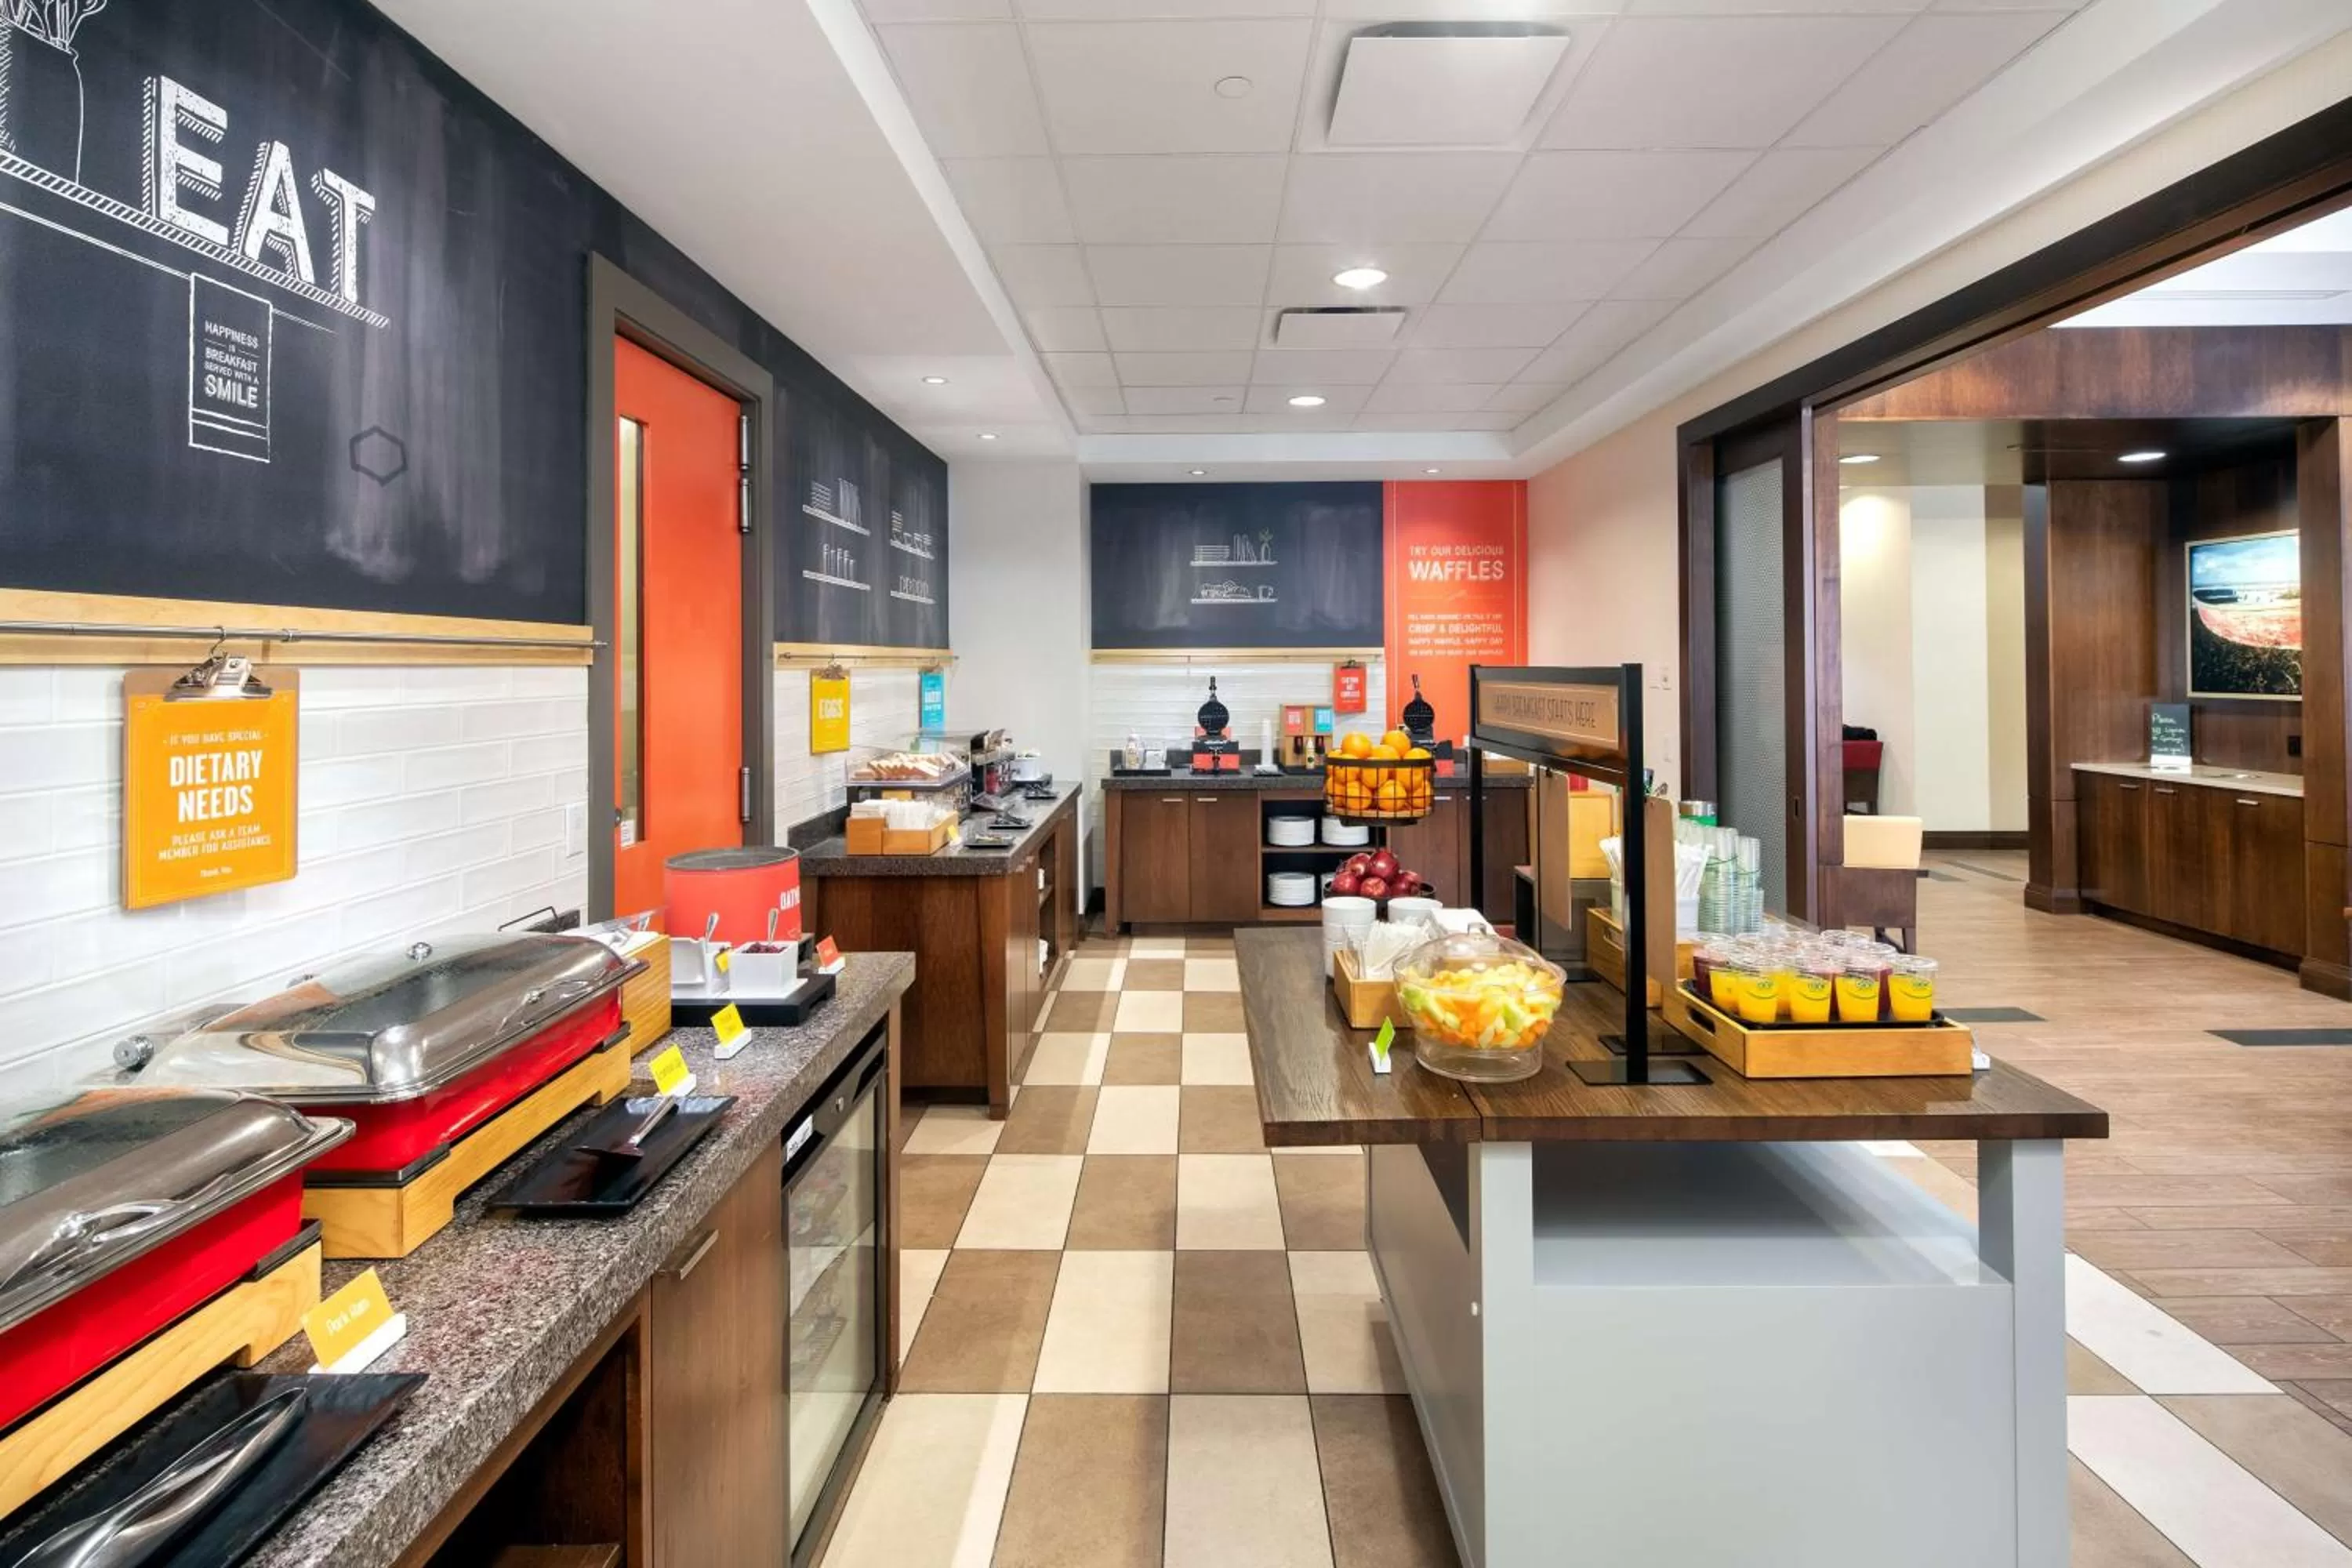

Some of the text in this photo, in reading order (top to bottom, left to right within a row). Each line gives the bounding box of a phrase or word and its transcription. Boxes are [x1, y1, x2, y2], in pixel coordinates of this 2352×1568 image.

[143, 75, 376, 303] EAT
[205, 320, 259, 349] HAPPINESS
[205, 347, 258, 373] BREAKFAST
[205, 360, 260, 385] SERVED WITH A
[205, 374, 259, 408] SMILE
[1410, 545, 1504, 556] TRY OUR DELICIOUS
[1408, 560, 1504, 581] WAFFLES
[1448, 623, 1504, 633] DELIGHTFUL
[182, 733, 200, 746] YOU
[202, 731, 226, 744] HAVE
[227, 730, 263, 742] SPECIAL
[169, 750, 263, 788] DIETARY
[178, 784, 254, 823] NEEDS
[158, 834, 272, 861] MEMBER FOR ASSISTANCE
[172, 823, 261, 847] PLEASE ASK A TEAM
